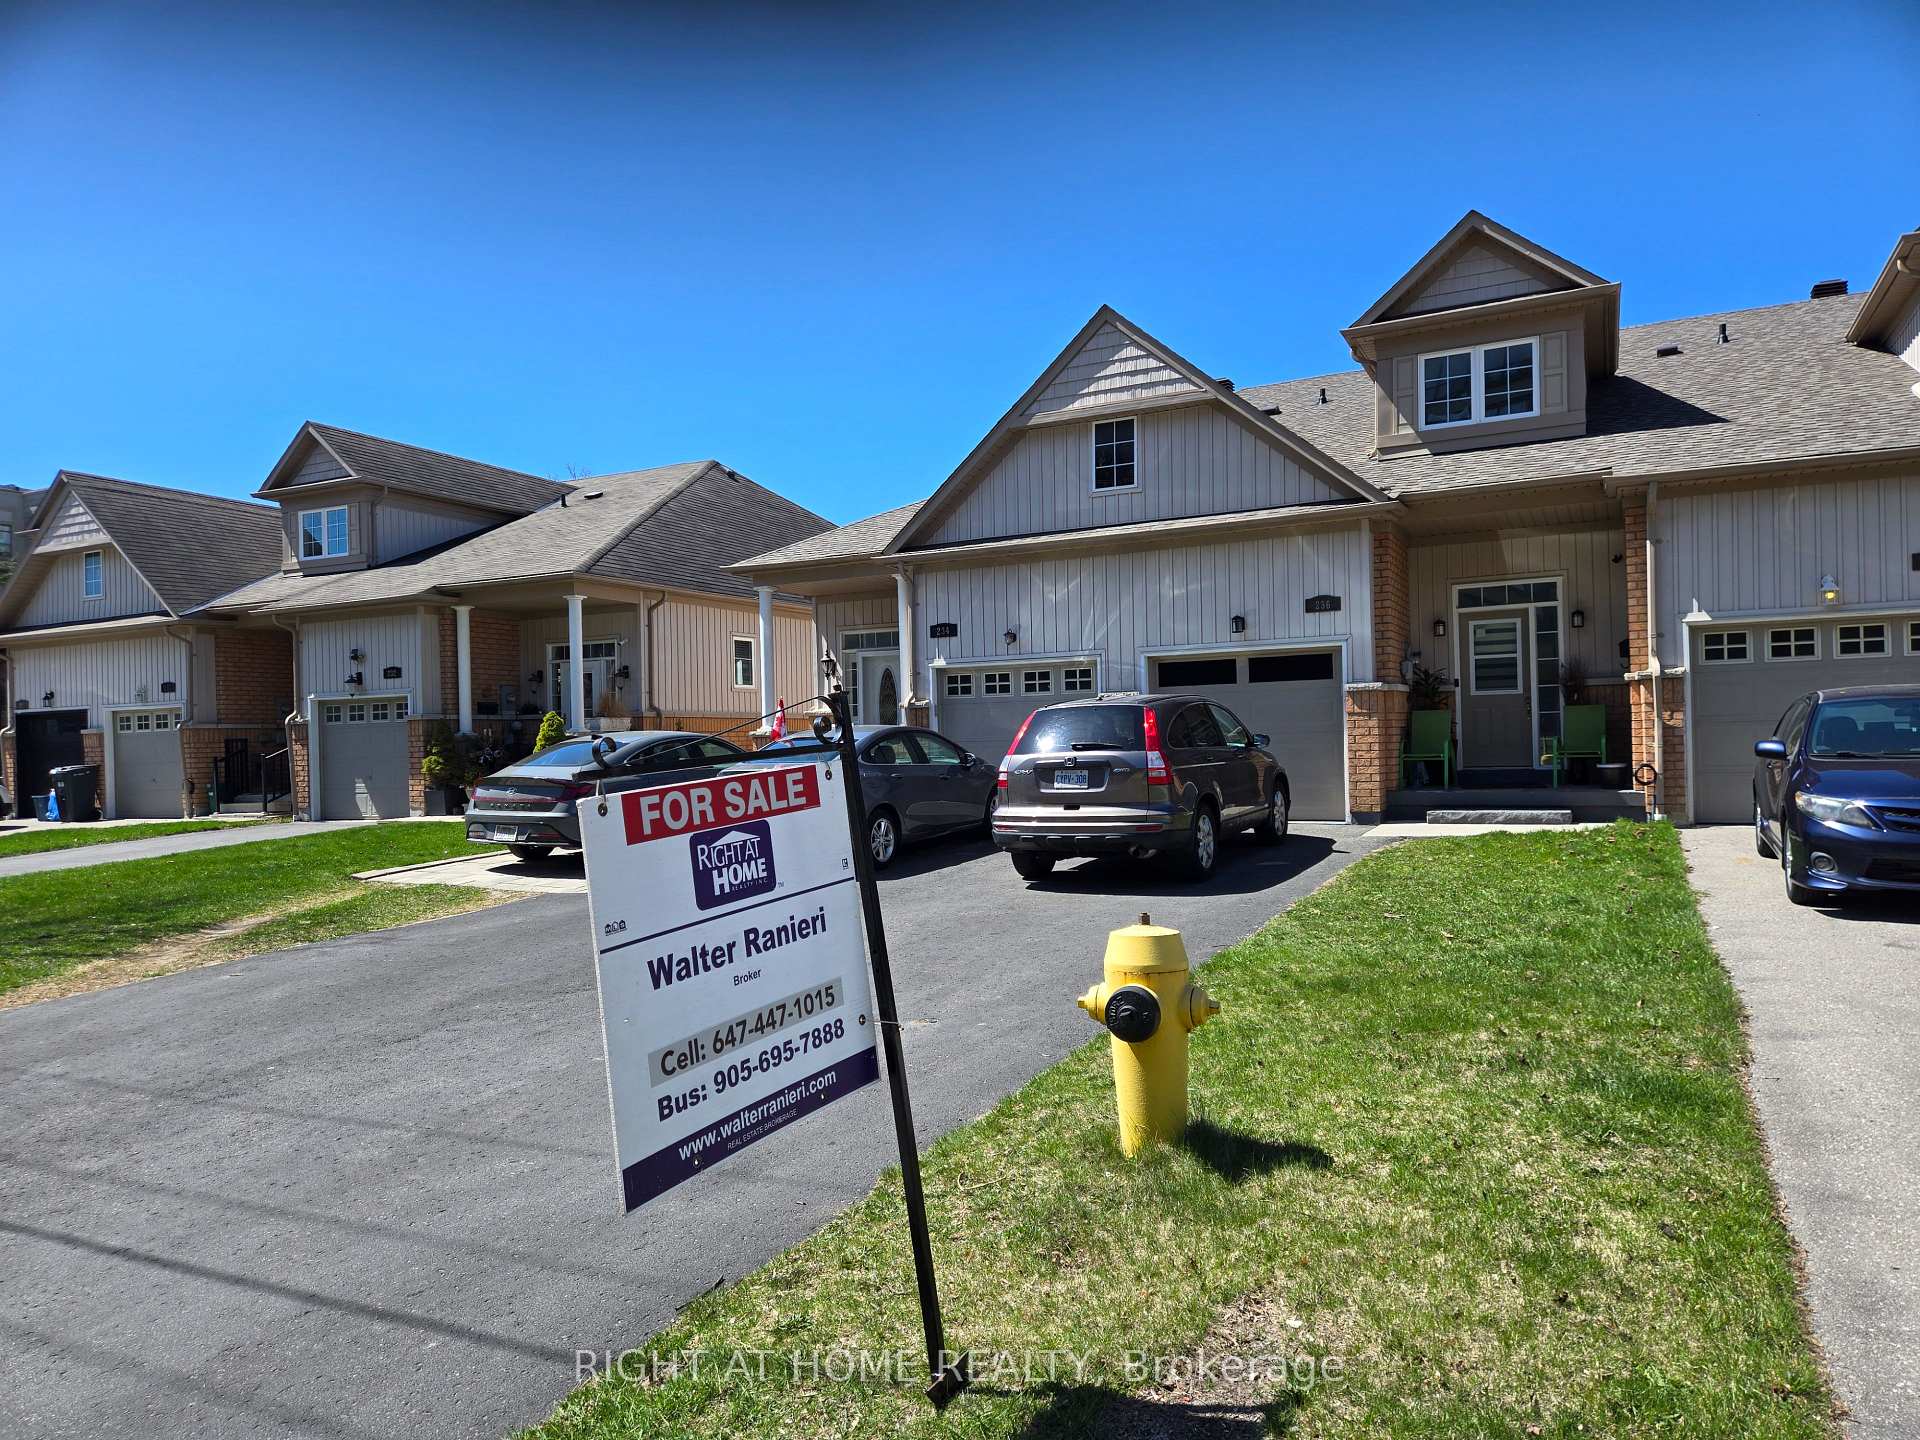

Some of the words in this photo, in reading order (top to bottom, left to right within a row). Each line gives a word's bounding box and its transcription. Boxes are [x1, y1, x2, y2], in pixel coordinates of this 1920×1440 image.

[639, 786, 715, 836] FOR
[724, 772, 807, 819] SALE
[697, 841, 743, 871] RIGHT
[745, 837, 761, 861] AT
[712, 857, 768, 896] HOME
[647, 939, 737, 990] Walter
[743, 906, 827, 957] Ranieri
[733, 968, 762, 987] Broker
[660, 1037, 706, 1076] Cell:
[712, 985, 836, 1055] 647-447-1015
[657, 1083, 708, 1123] Bus:
[713, 1018, 845, 1094] 905-695-7888
[678, 1070, 837, 1161] www.walterranieri.com
[727, 1138, 743, 1151] REAL
[743, 1124, 764, 1143] ESTATE
[763, 1108, 798, 1132] BROKERAGE
